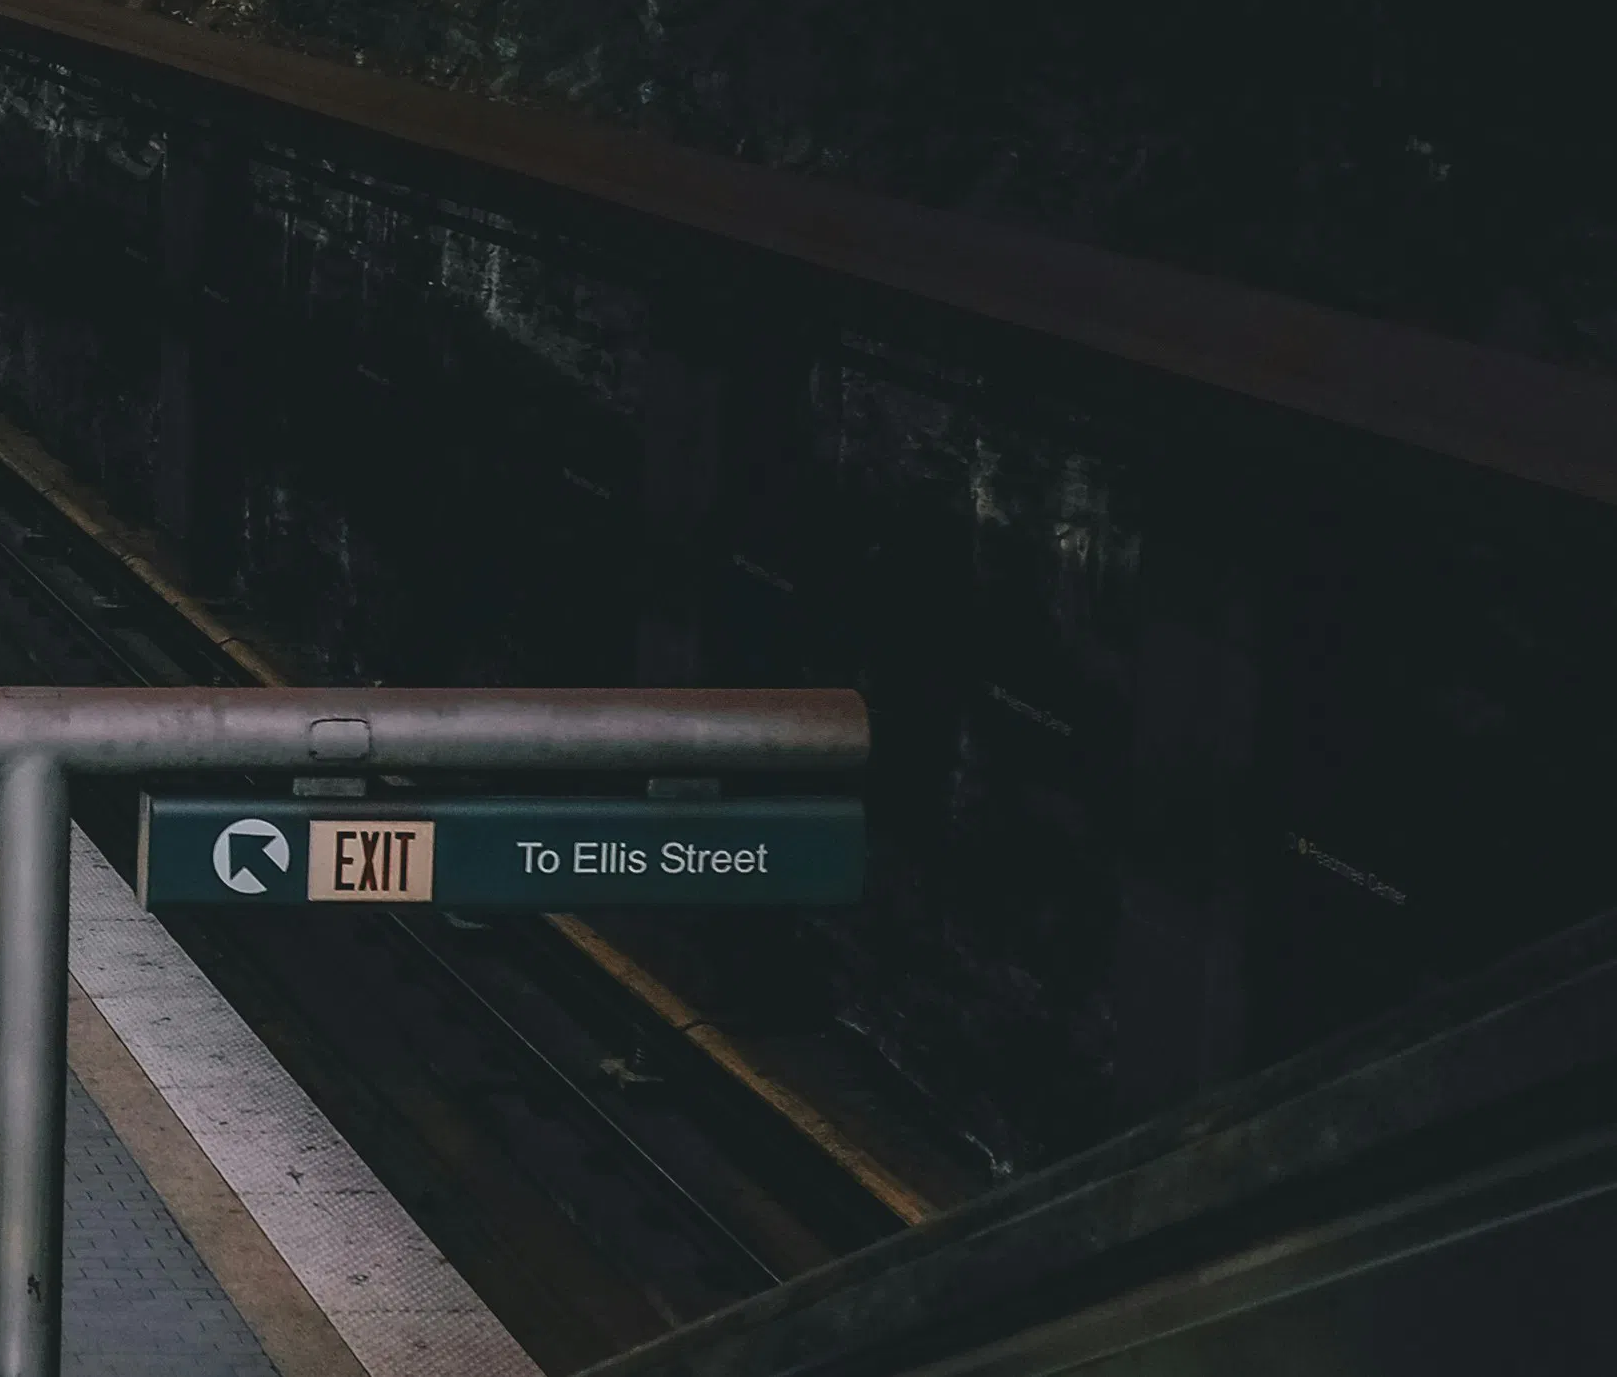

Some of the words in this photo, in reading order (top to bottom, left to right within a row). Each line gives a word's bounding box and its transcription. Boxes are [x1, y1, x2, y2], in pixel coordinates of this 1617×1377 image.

[334, 831, 416, 891] EXIT
[517, 842, 560, 874] To
[574, 842, 646, 874] Ellis
[661, 842, 768, 874] Street
